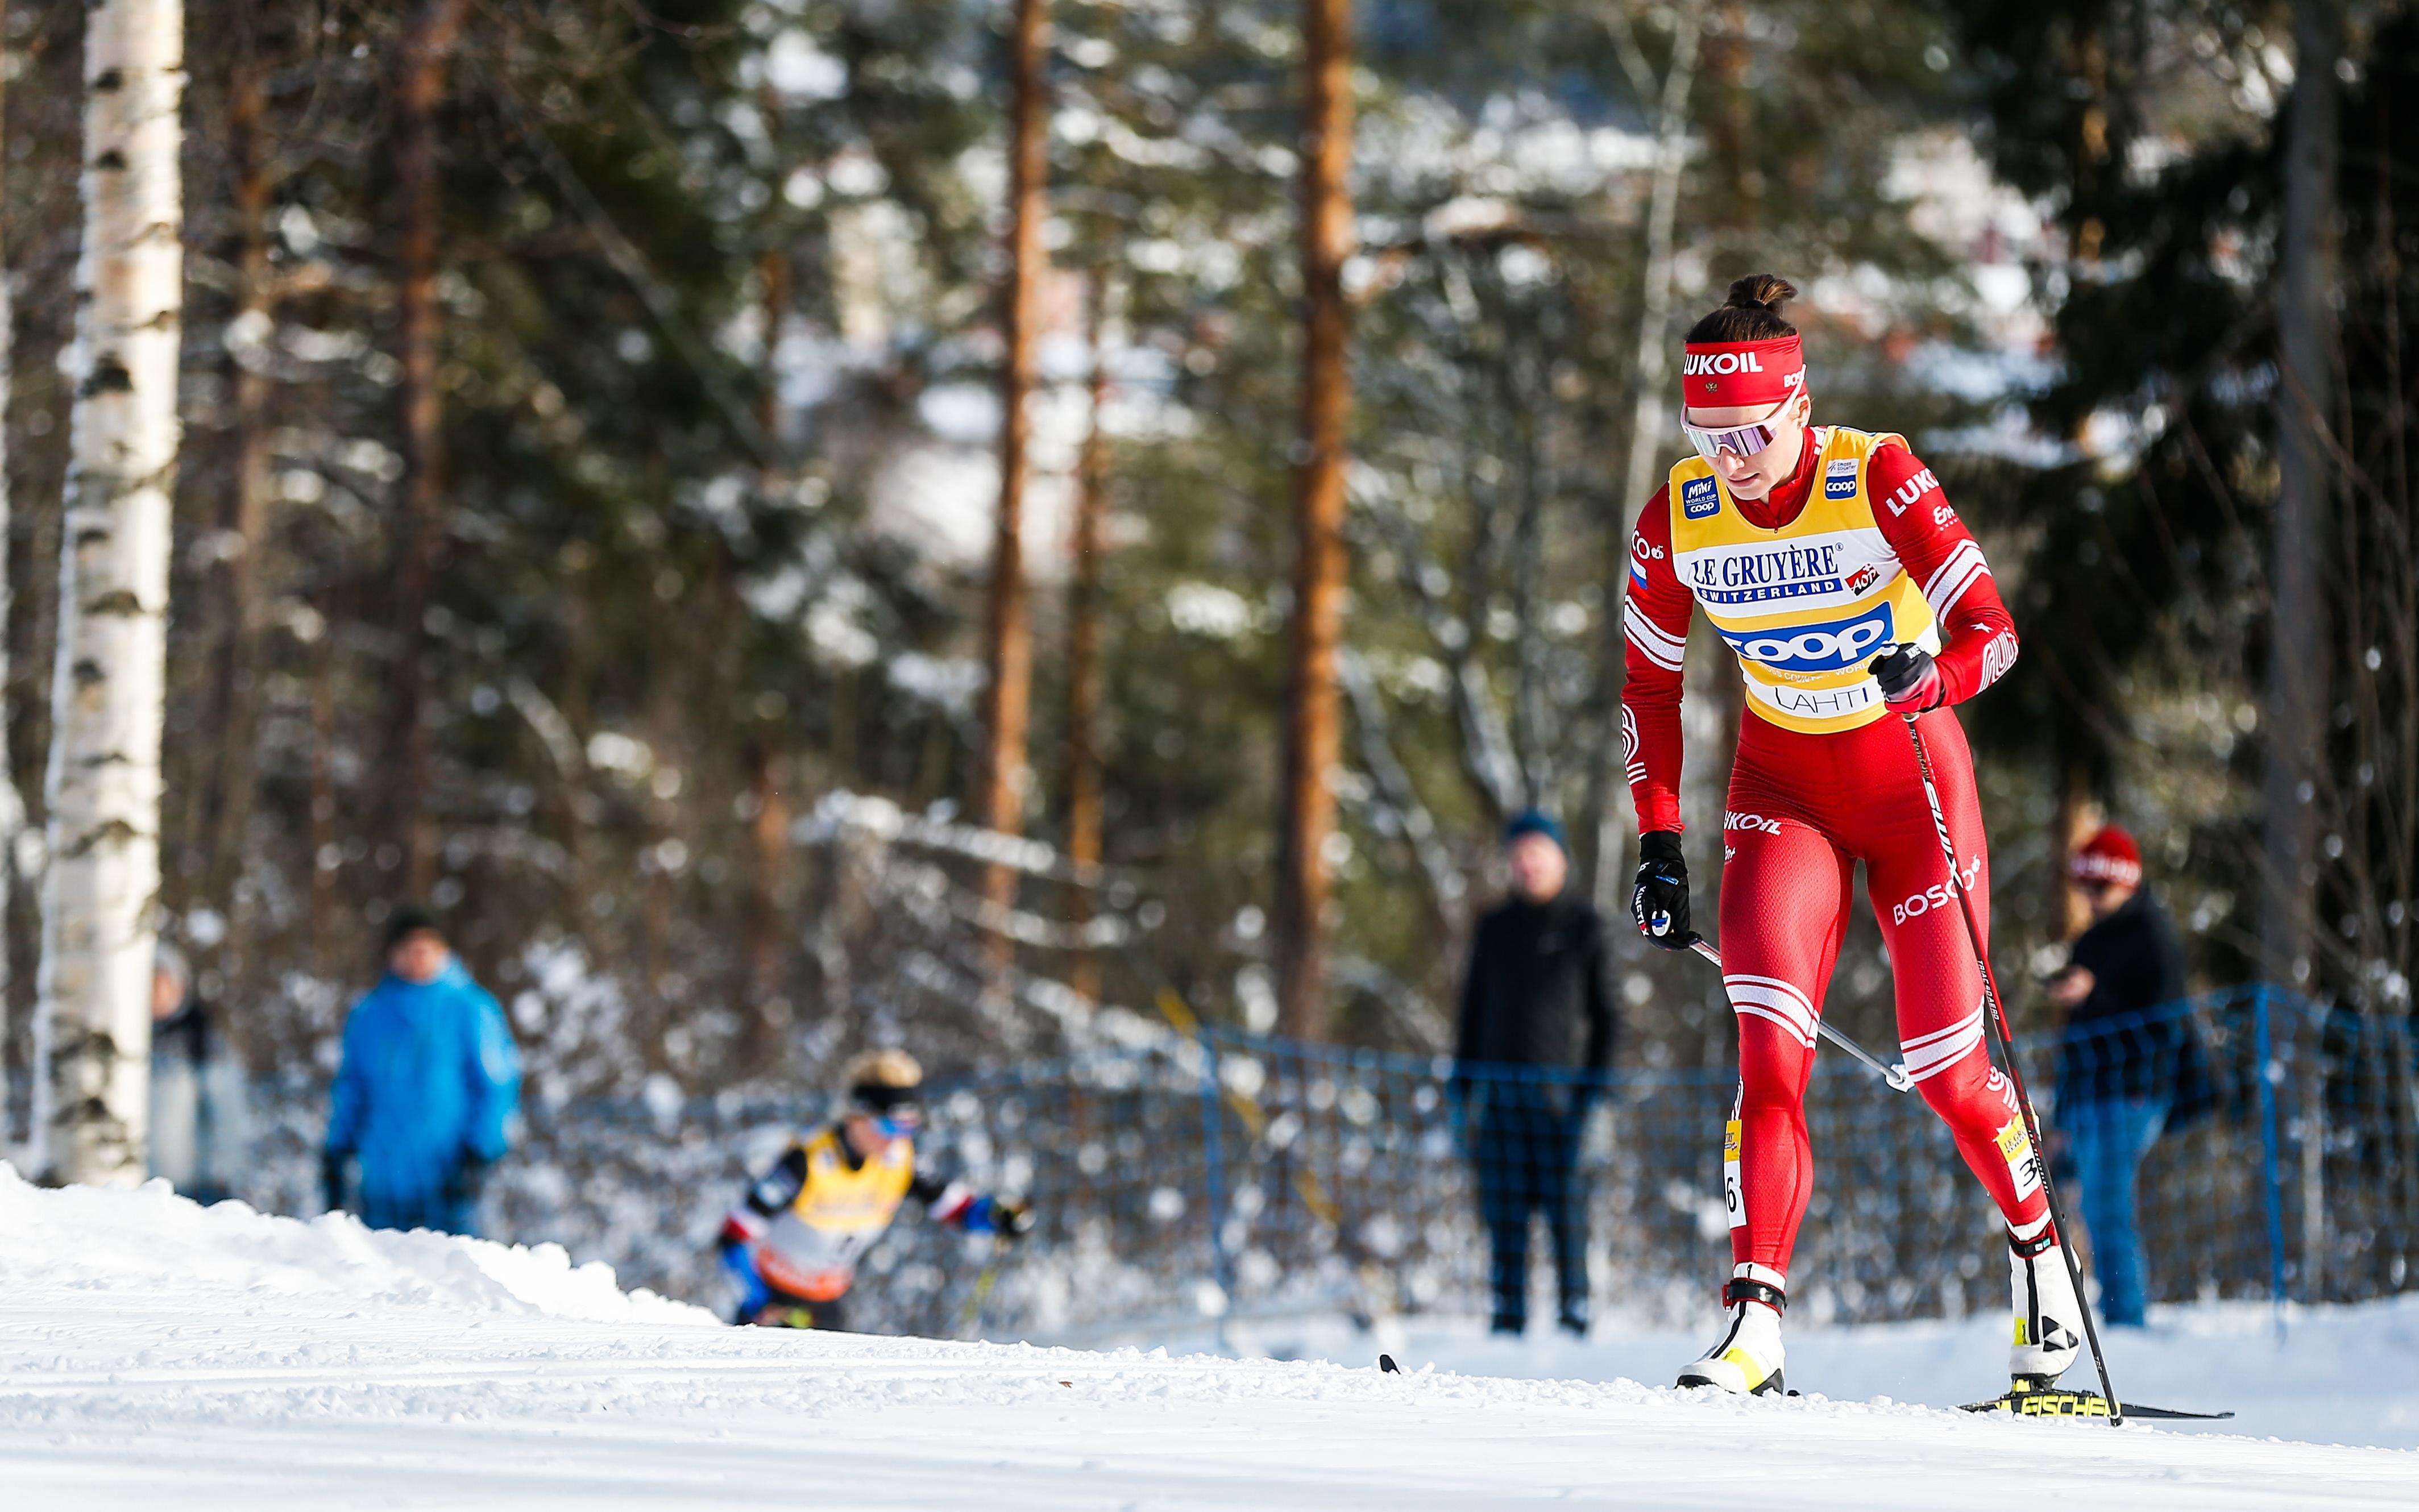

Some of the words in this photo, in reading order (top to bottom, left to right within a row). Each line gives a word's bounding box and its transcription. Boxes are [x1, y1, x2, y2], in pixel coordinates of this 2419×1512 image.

[1826, 481, 1856, 493] coop
[1690, 502, 1715, 513] coop
[1691, 559, 1717, 585] LE
[1701, 580, 1836, 603] SWITZERLAND
[1721, 619, 1885, 662] coop
[1775, 687, 1869, 714] LAHTI
[2019, 1157, 2038, 1187] 3
[1727, 1176, 1737, 1213] 6
